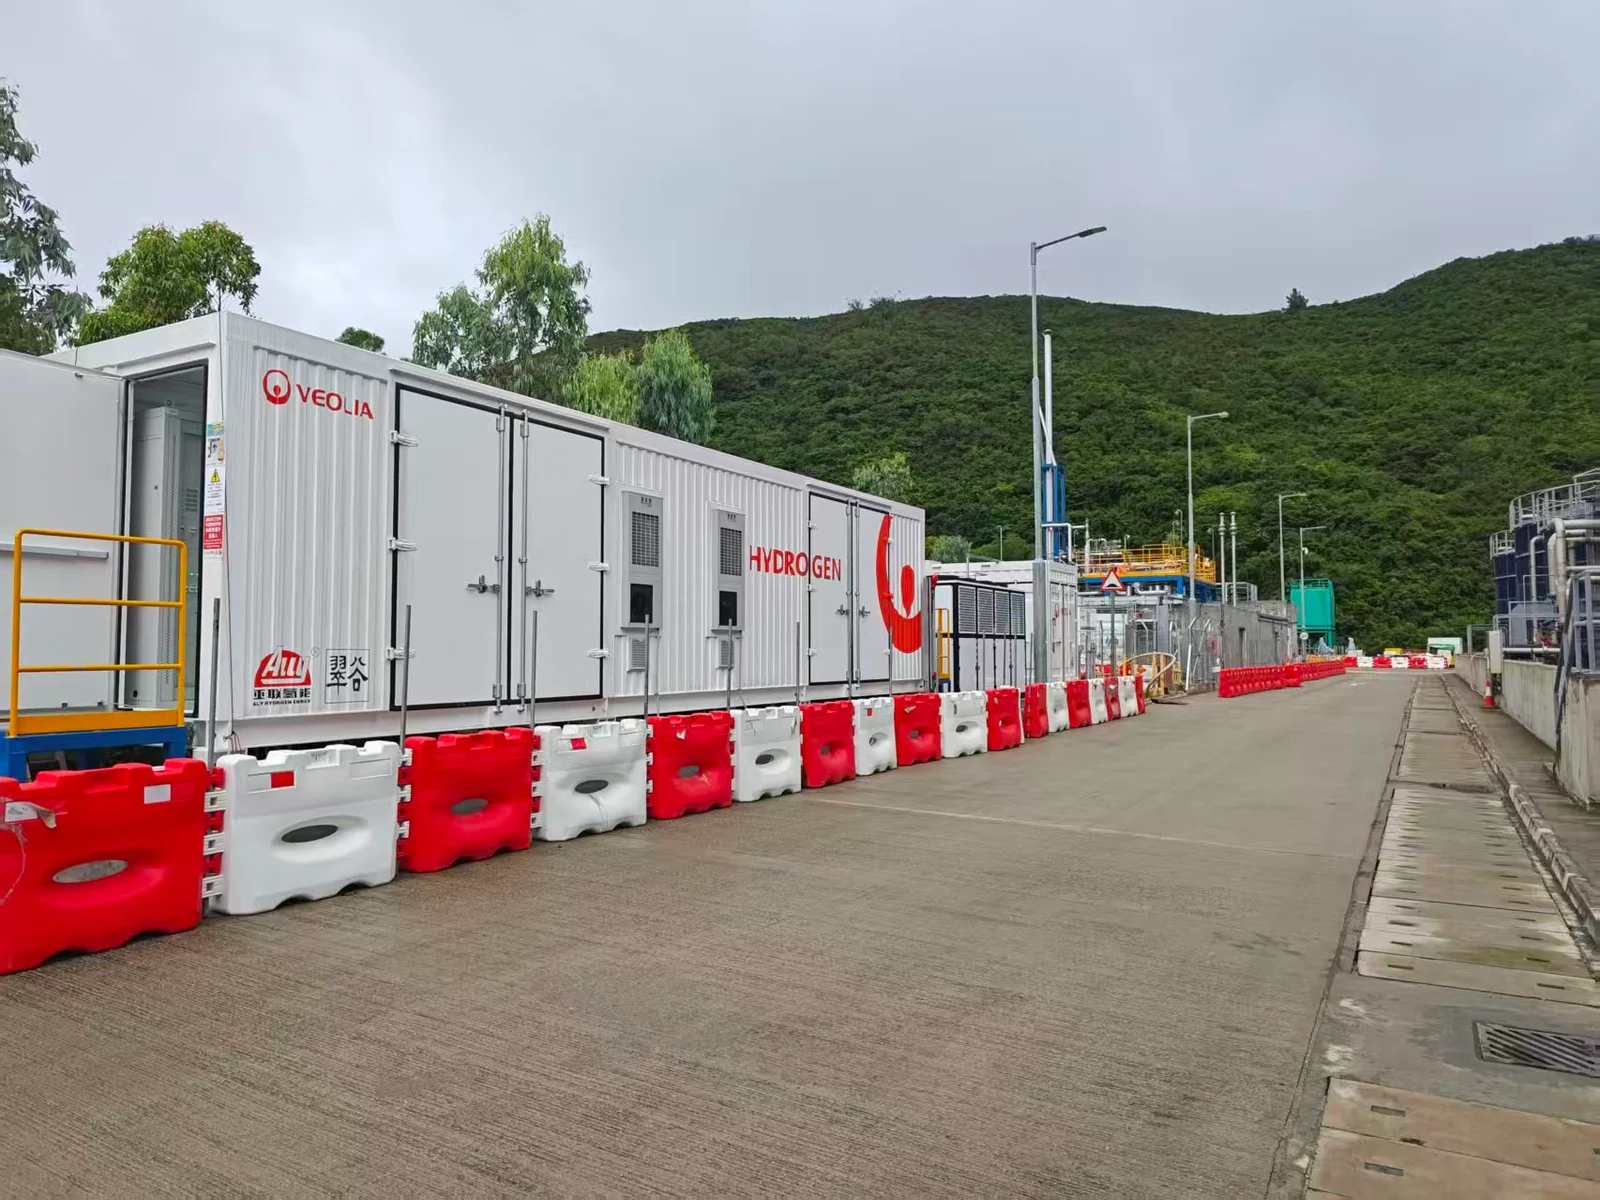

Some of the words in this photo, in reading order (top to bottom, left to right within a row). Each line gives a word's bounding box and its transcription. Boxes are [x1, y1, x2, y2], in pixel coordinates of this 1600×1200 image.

[296, 383, 374, 419] VEOLIA
[750, 545, 841, 581] HYDROGEN
[326, 655, 368, 695] 翠谷
